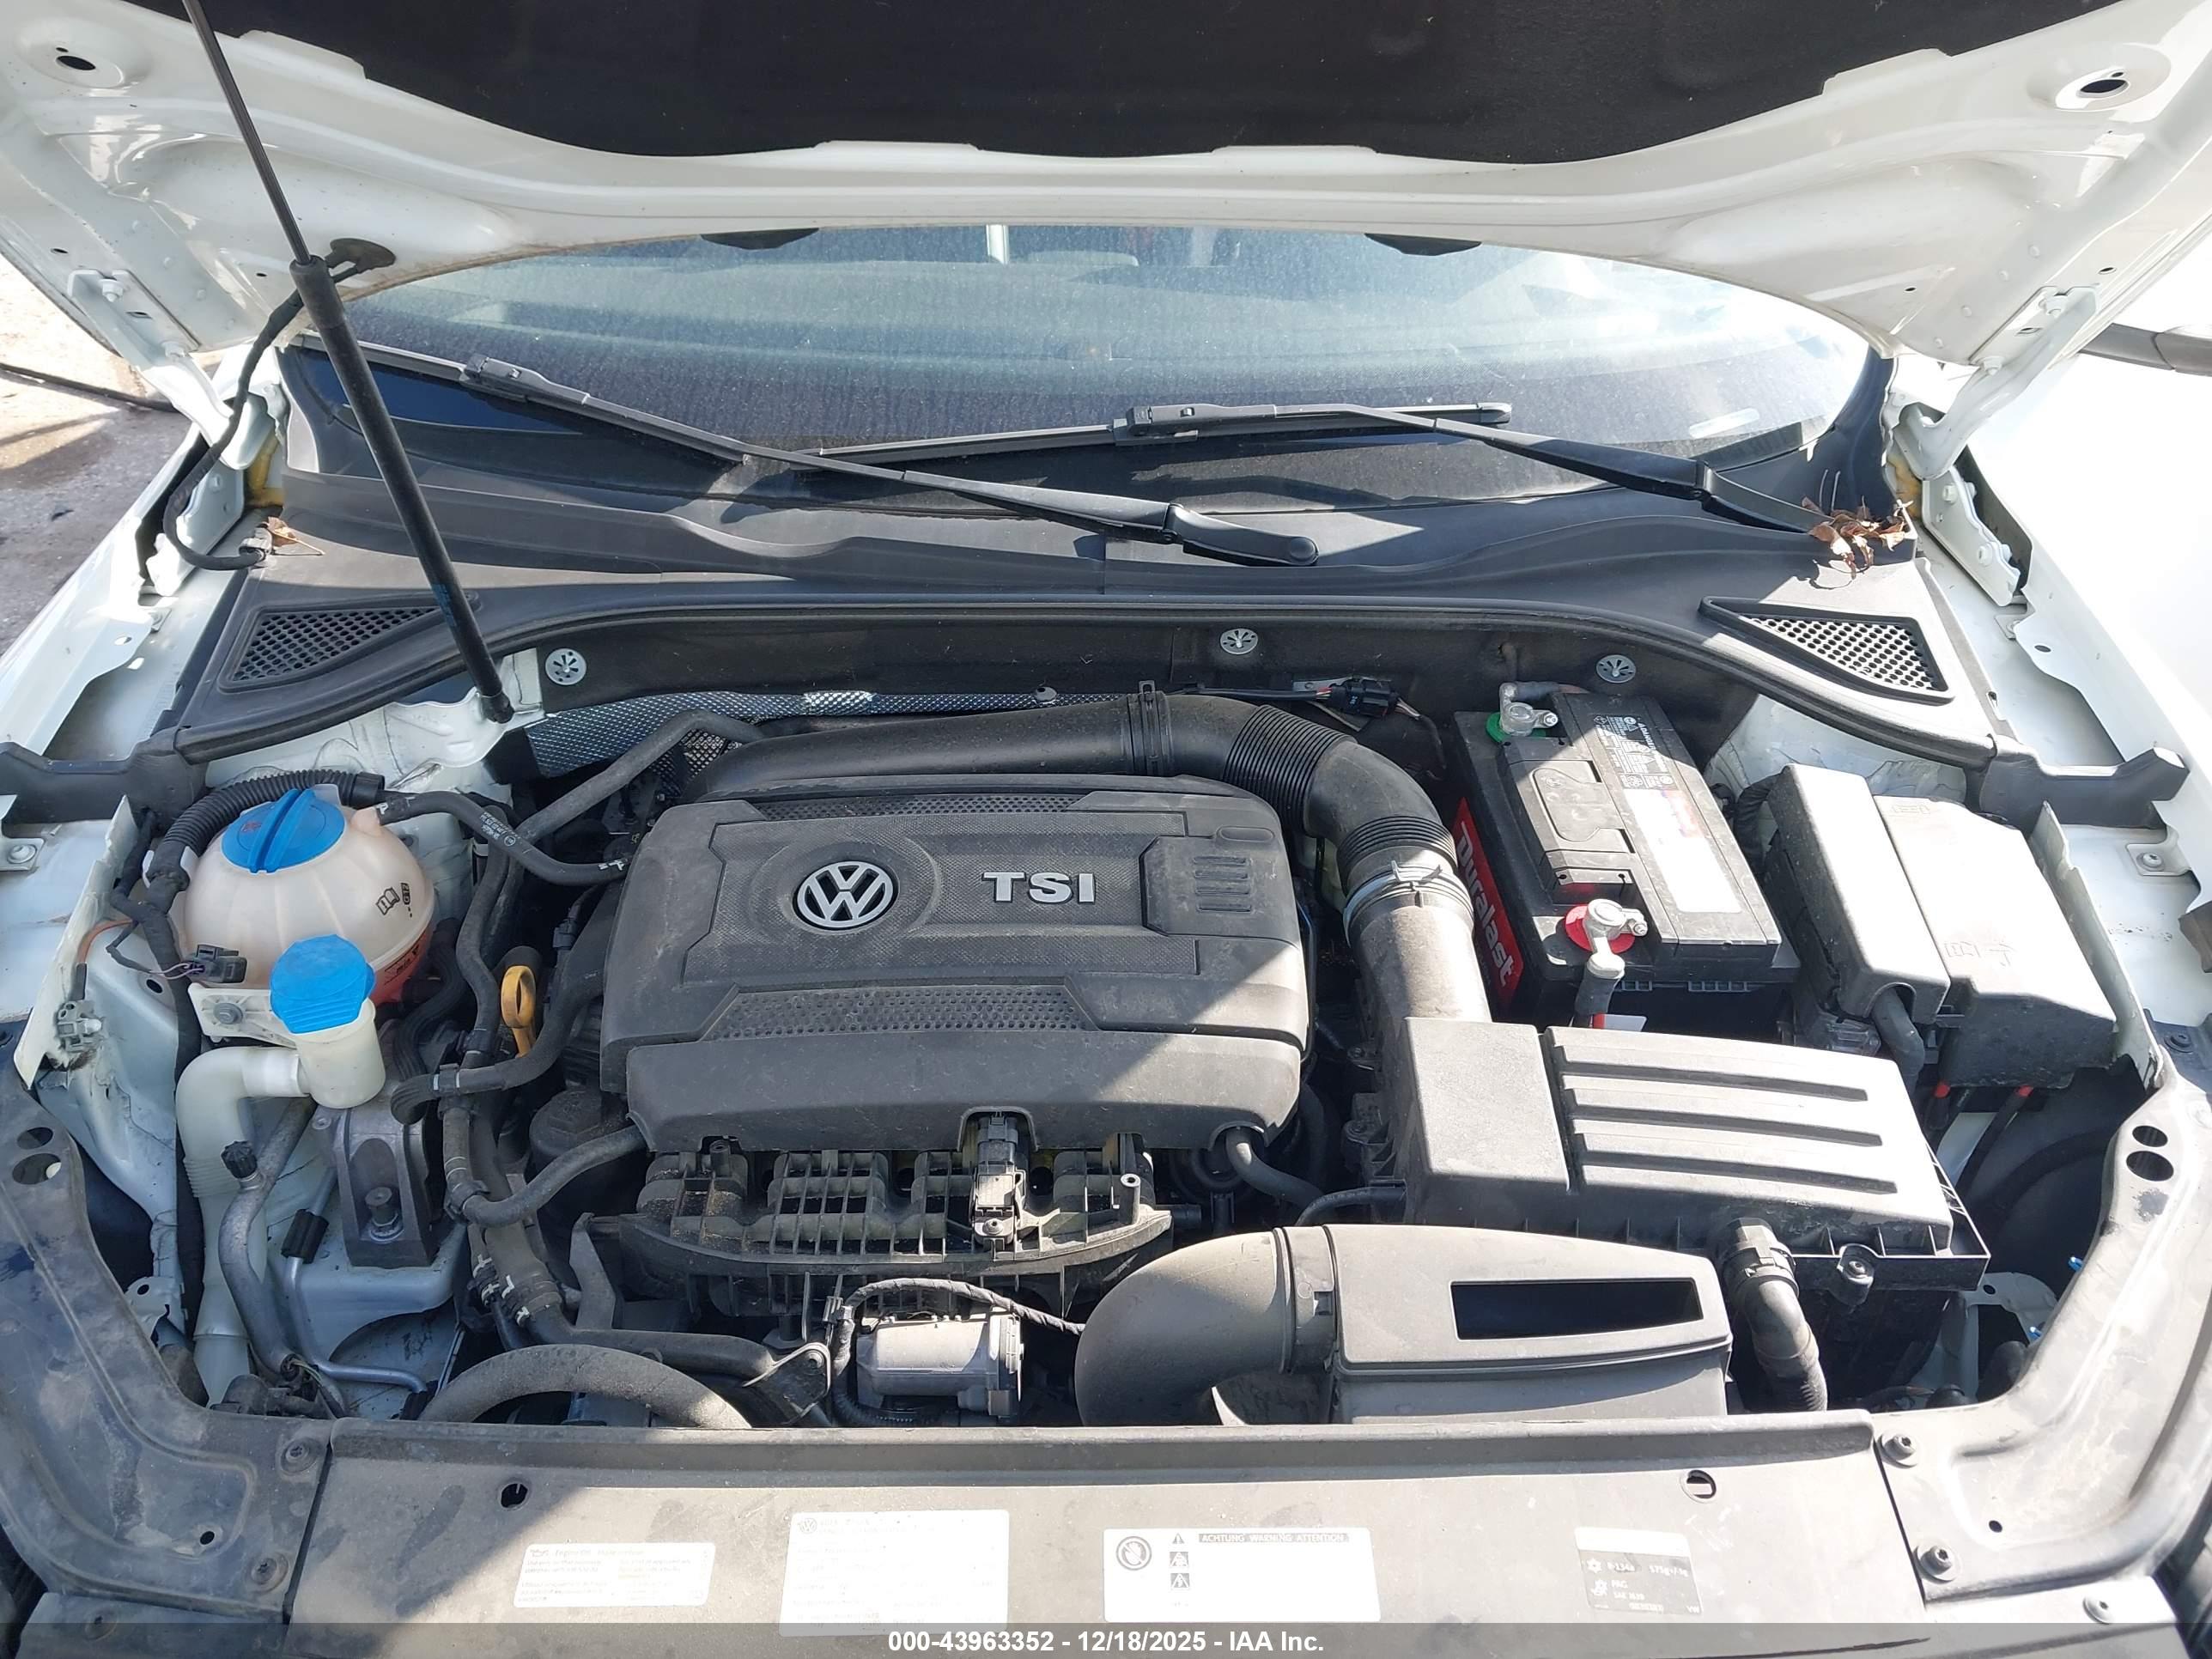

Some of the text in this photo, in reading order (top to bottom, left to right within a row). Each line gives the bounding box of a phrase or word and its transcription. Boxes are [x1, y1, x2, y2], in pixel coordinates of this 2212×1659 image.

[797, 860, 894, 928] VW
[982, 872, 1096, 902] TSI
[1457, 821, 1513, 987] Duralast
[1201, 1534, 1345, 1543] ACHTUNG WARNING ATTENTION
